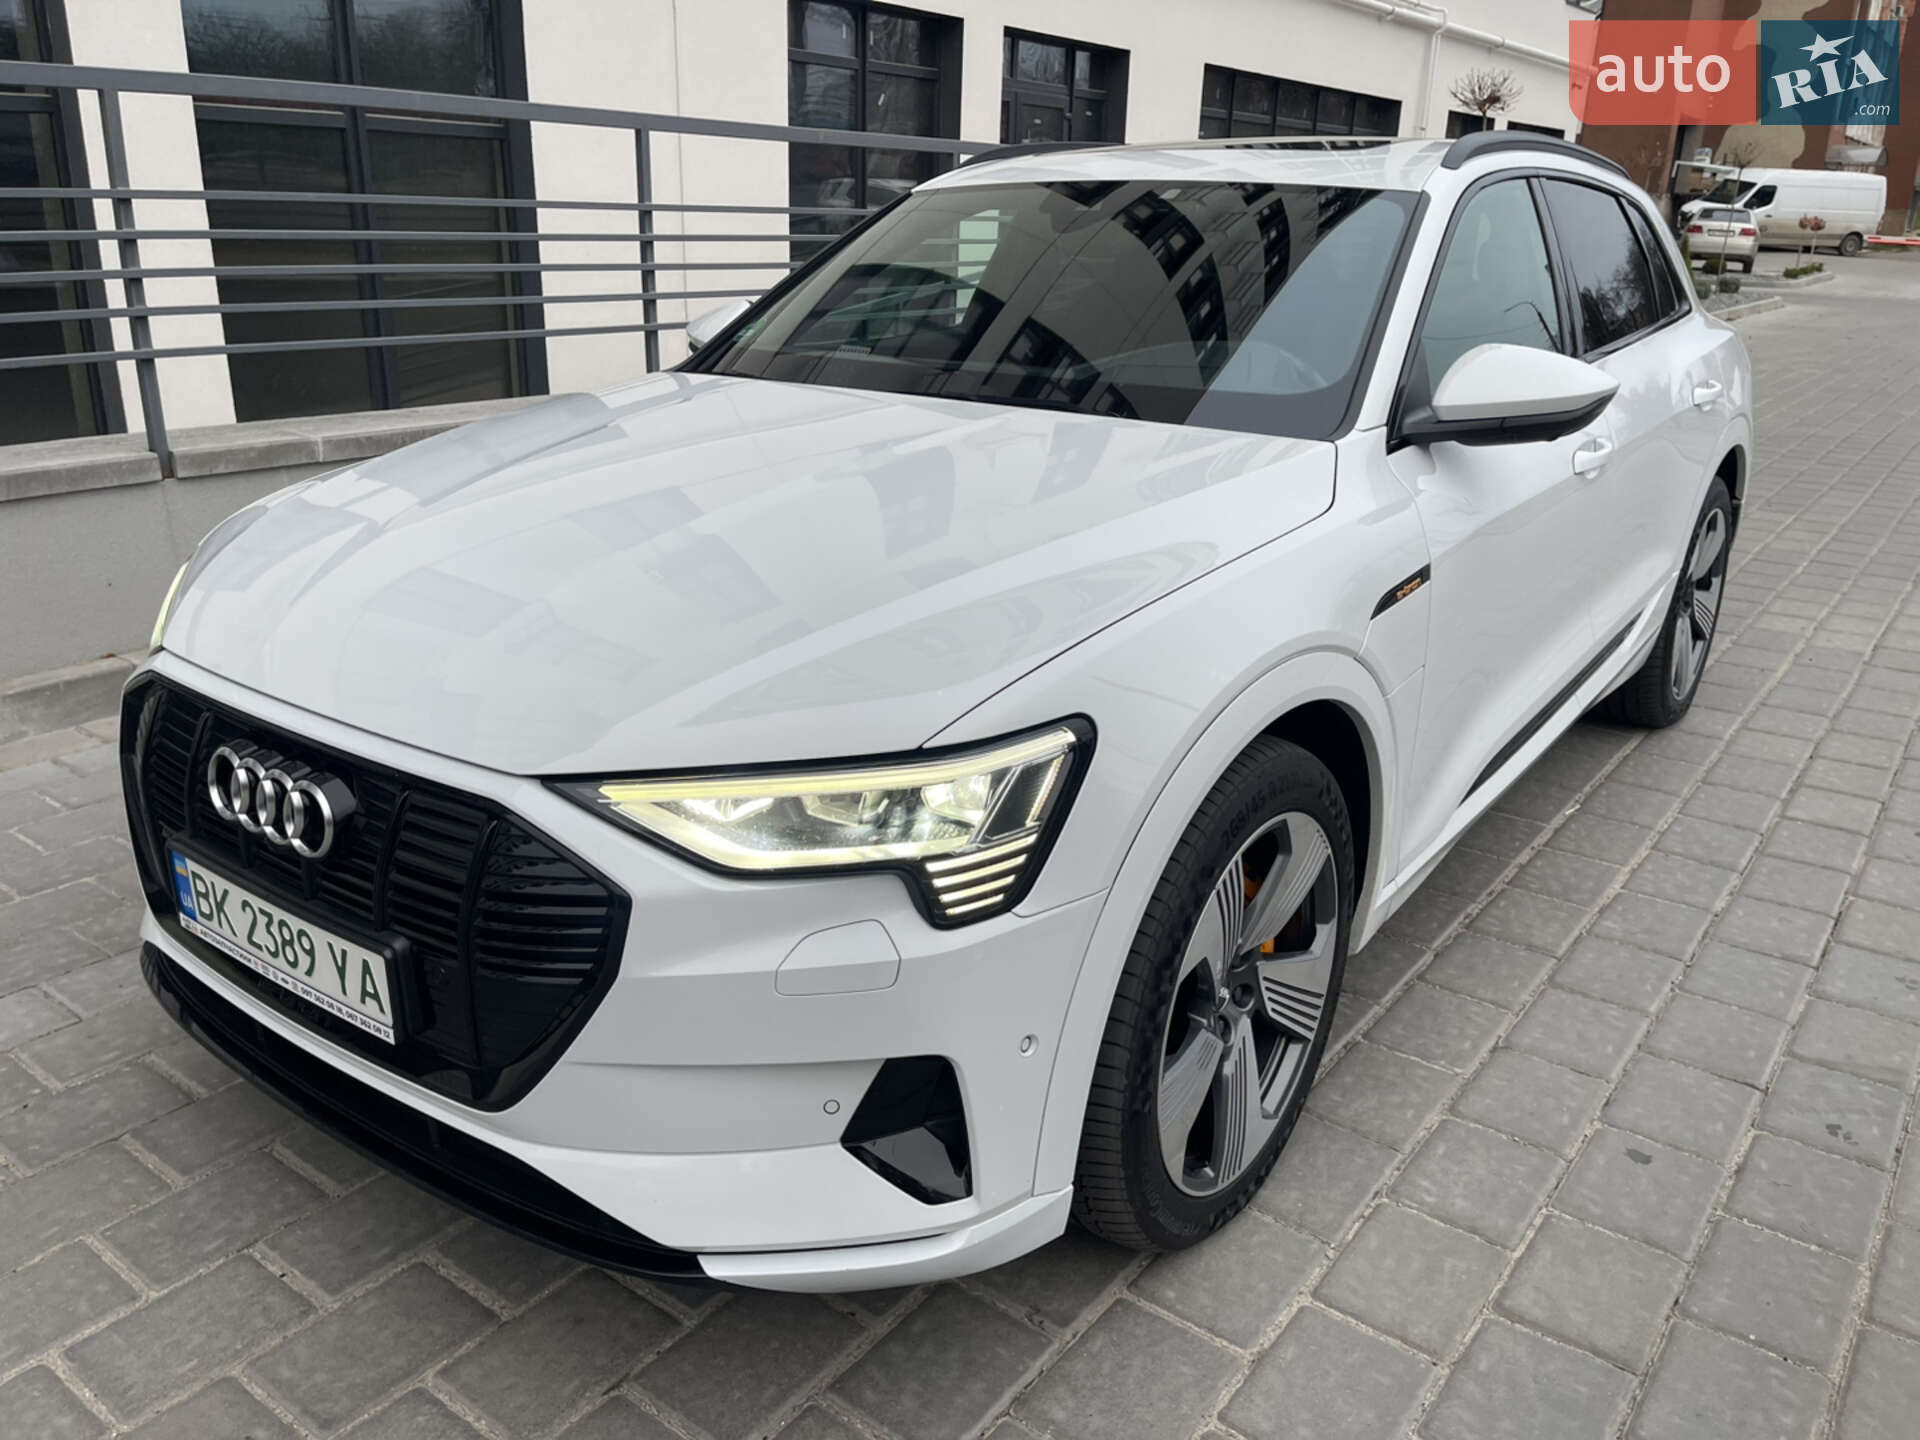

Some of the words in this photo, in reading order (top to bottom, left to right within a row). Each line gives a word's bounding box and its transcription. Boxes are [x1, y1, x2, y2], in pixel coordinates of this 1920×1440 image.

[181, 892, 194, 911] UA
[191, 870, 238, 937] BK
[241, 899, 315, 977] 2389
[327, 940, 386, 1015] YA
